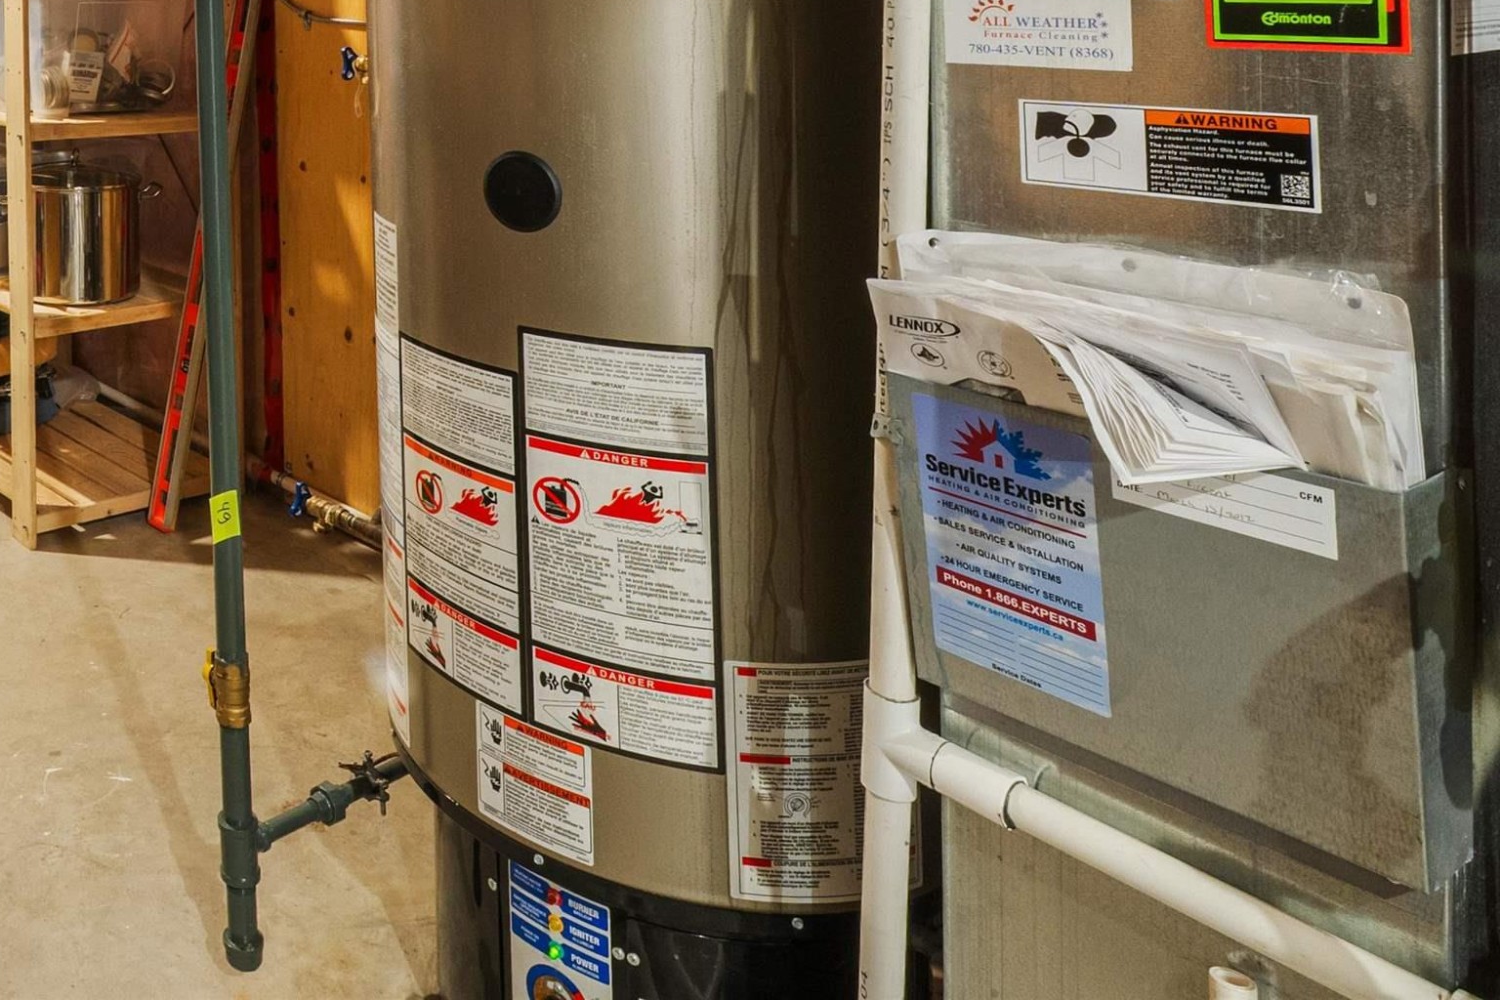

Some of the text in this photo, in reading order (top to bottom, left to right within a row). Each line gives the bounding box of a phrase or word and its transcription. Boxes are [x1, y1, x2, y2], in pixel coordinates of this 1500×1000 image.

[982, 16, 1098, 29] ALL WEATHER
[1261, 11, 1332, 26] Edmonton
[984, 30, 1098, 42] Furnace Cleaning
[969, 43, 1114, 60] 780-435-VENT (8368)
[1149, 126, 1191, 134] Asphyxiation
[1191, 114, 1277, 130] WARNING
[1239, 154, 1267, 162] furnace
[1174, 164, 1210, 173] inspection
[1236, 169, 1264, 177] furnace
[889, 315, 945, 334] LENNOX
[591, 380, 626, 390] IMPORTANT
[566, 407, 579, 416] AVIS
[621, 416, 659, 426] CALIFORNIE
[593, 451, 648, 468] DANGER
[925, 453, 1086, 518] Service Experts
[928, 475, 971, 493] HEATING
[984, 491, 1000, 503] AIR
[1004, 498, 1086, 529] CONDITIONING
[1299, 491, 1323, 504] CFM
[942, 499, 1076, 549] HEATING & AIR CONDITIONING
[938, 516, 1084, 572] SALES SERVICE & INSTALLATION
[961, 543, 1062, 585] AIR QUALITY SYSTEMS
[944, 555, 1084, 613] 24 HOUR EMERGENCY SERVICE
[943, 572, 1087, 634] Phone 1.866.EXPERTS
[439, 602, 477, 631] DANGER
[966, 598, 1064, 641] www.serviceexperts.ca
[602, 670, 655, 689] DANGER
[991, 663, 1042, 688] Service Dates
[526, 725, 569, 750] WARNING
[512, 767, 590, 809] AVERTISSEMENT
[568, 898, 600, 919] BURNER
[569, 925, 600, 946] IGNITER
[571, 953, 599, 974] POWER
